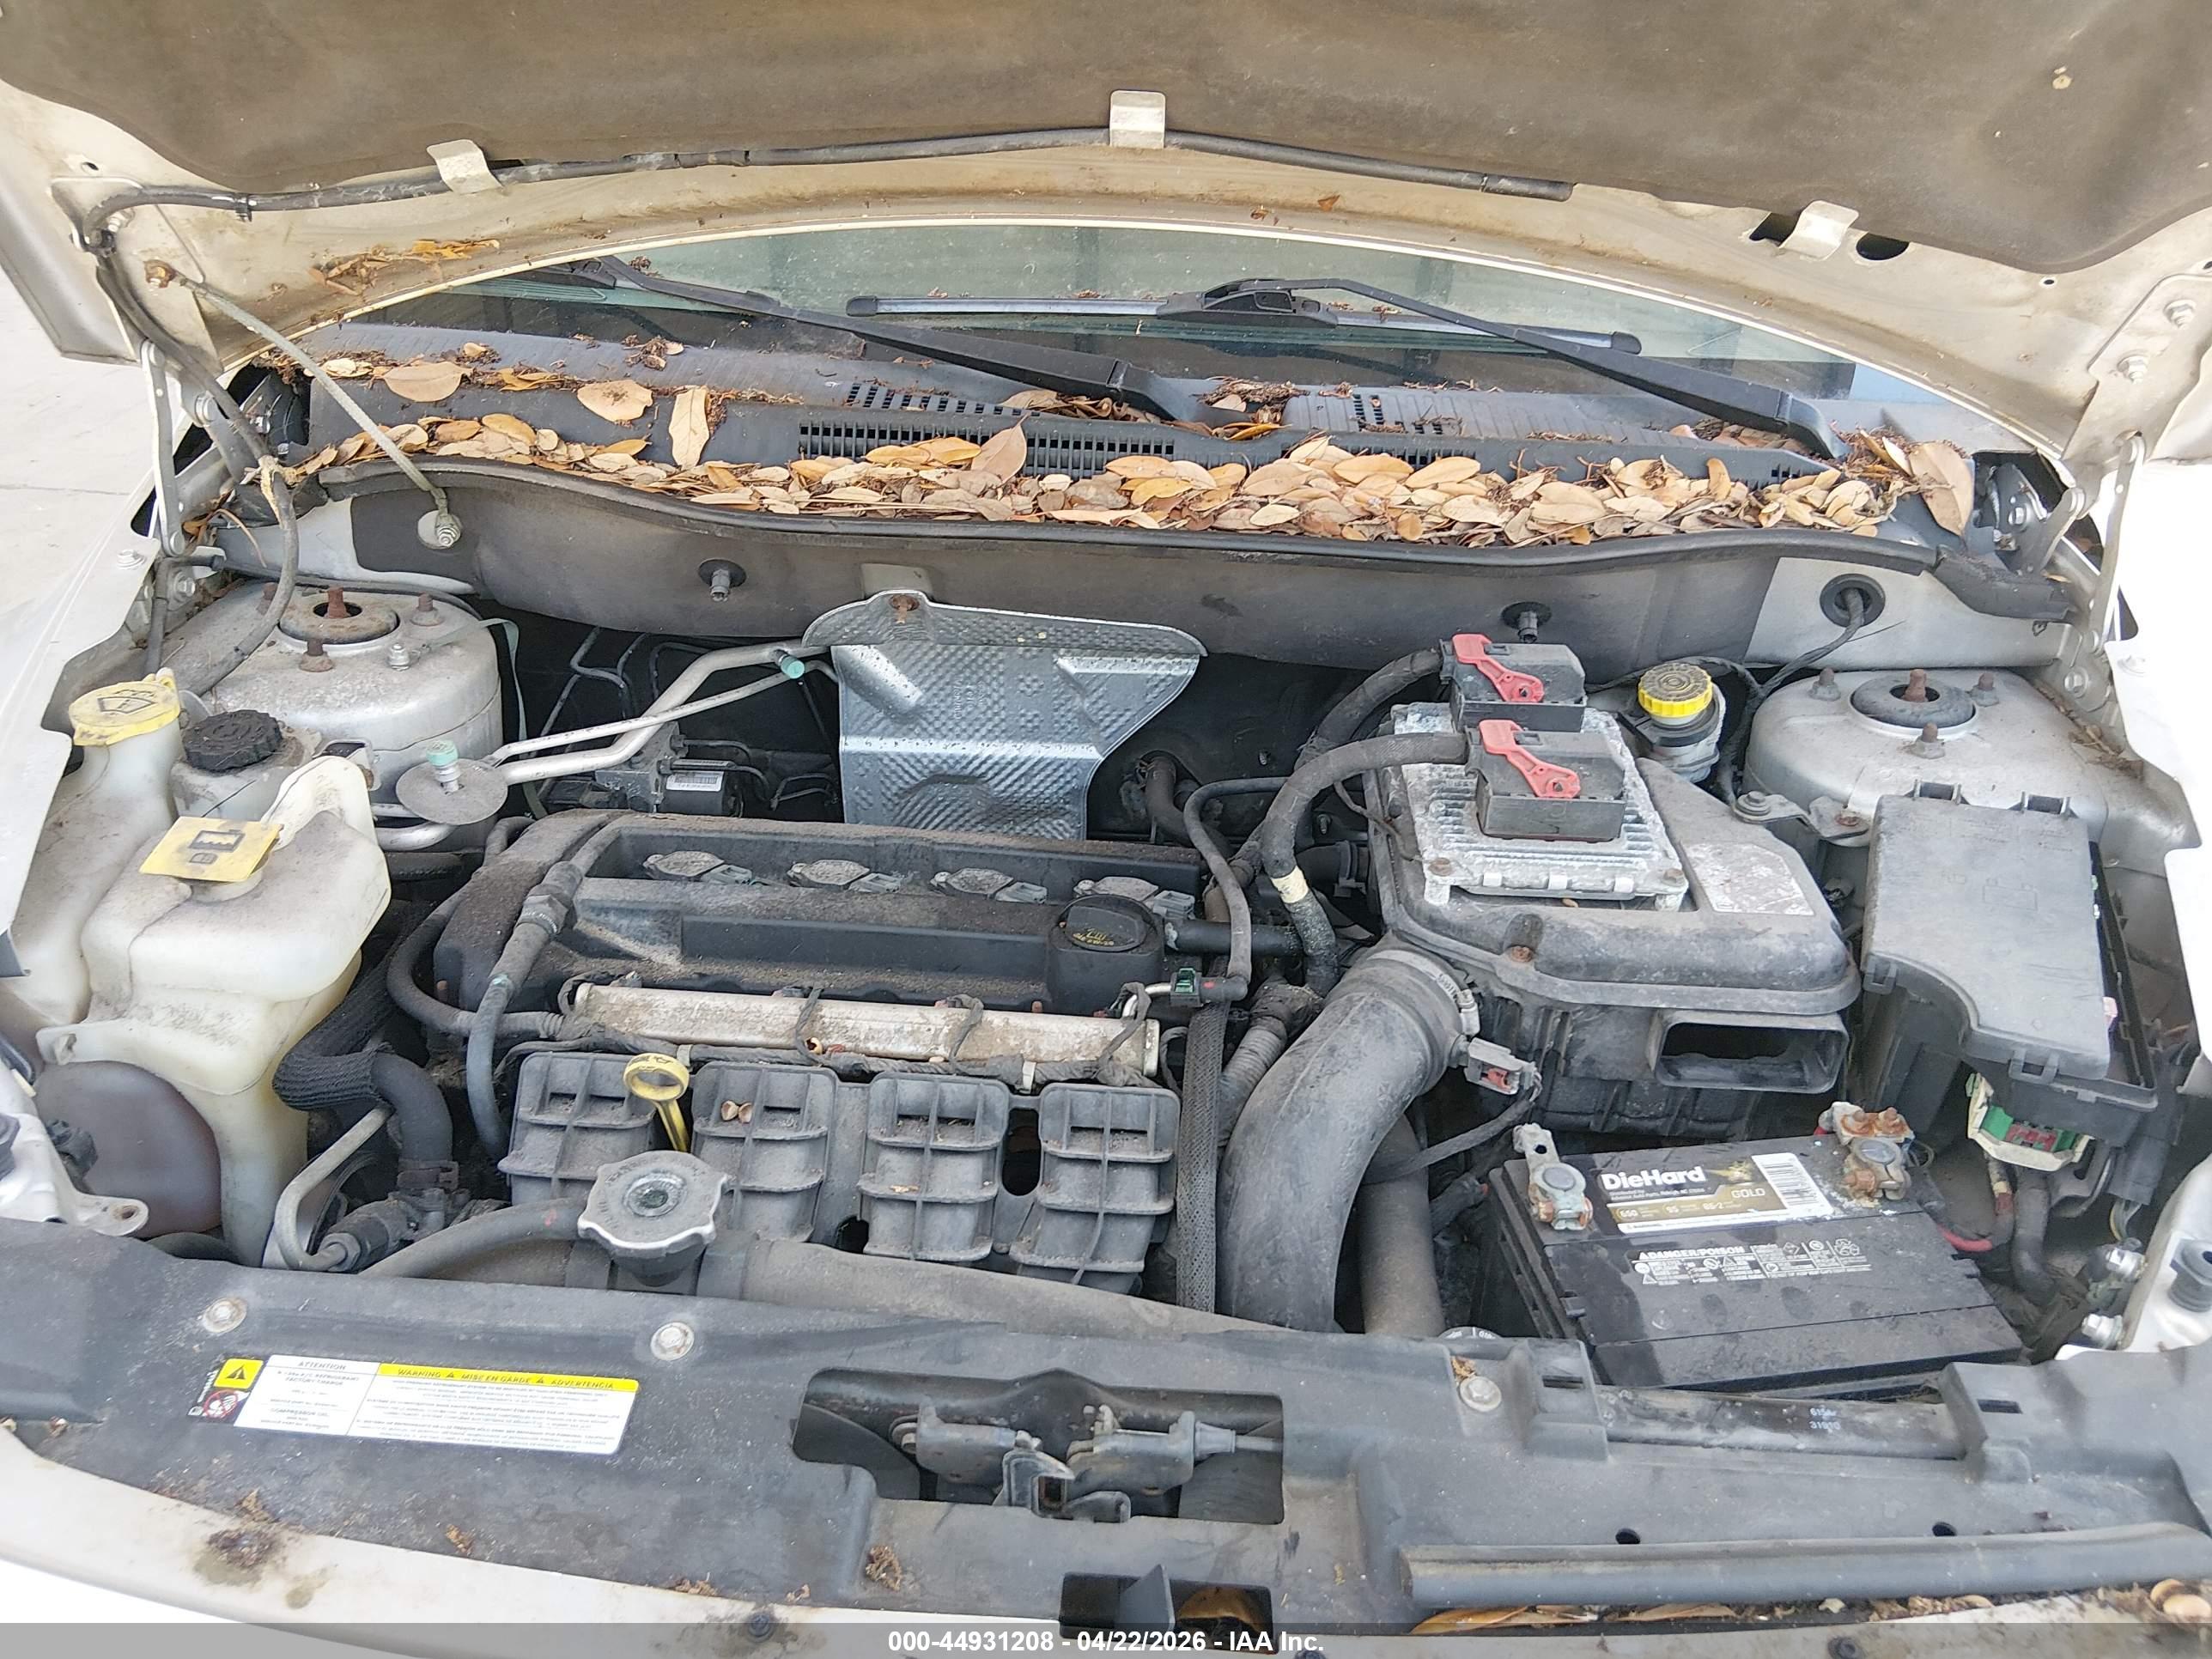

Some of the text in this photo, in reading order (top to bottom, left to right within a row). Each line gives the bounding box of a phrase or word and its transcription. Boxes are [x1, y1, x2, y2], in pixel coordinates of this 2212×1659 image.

[1600, 1165, 1707, 1191] DieHard
[1730, 1188, 1766, 1199] GOLD
[298, 1360, 347, 1371] ATTENTION
[398, 1368, 441, 1378] WARNING
[461, 1372, 483, 1381] MISE
[500, 1376, 532, 1384] GARDE
[550, 1379, 615, 1390] ADVERTENCIA
